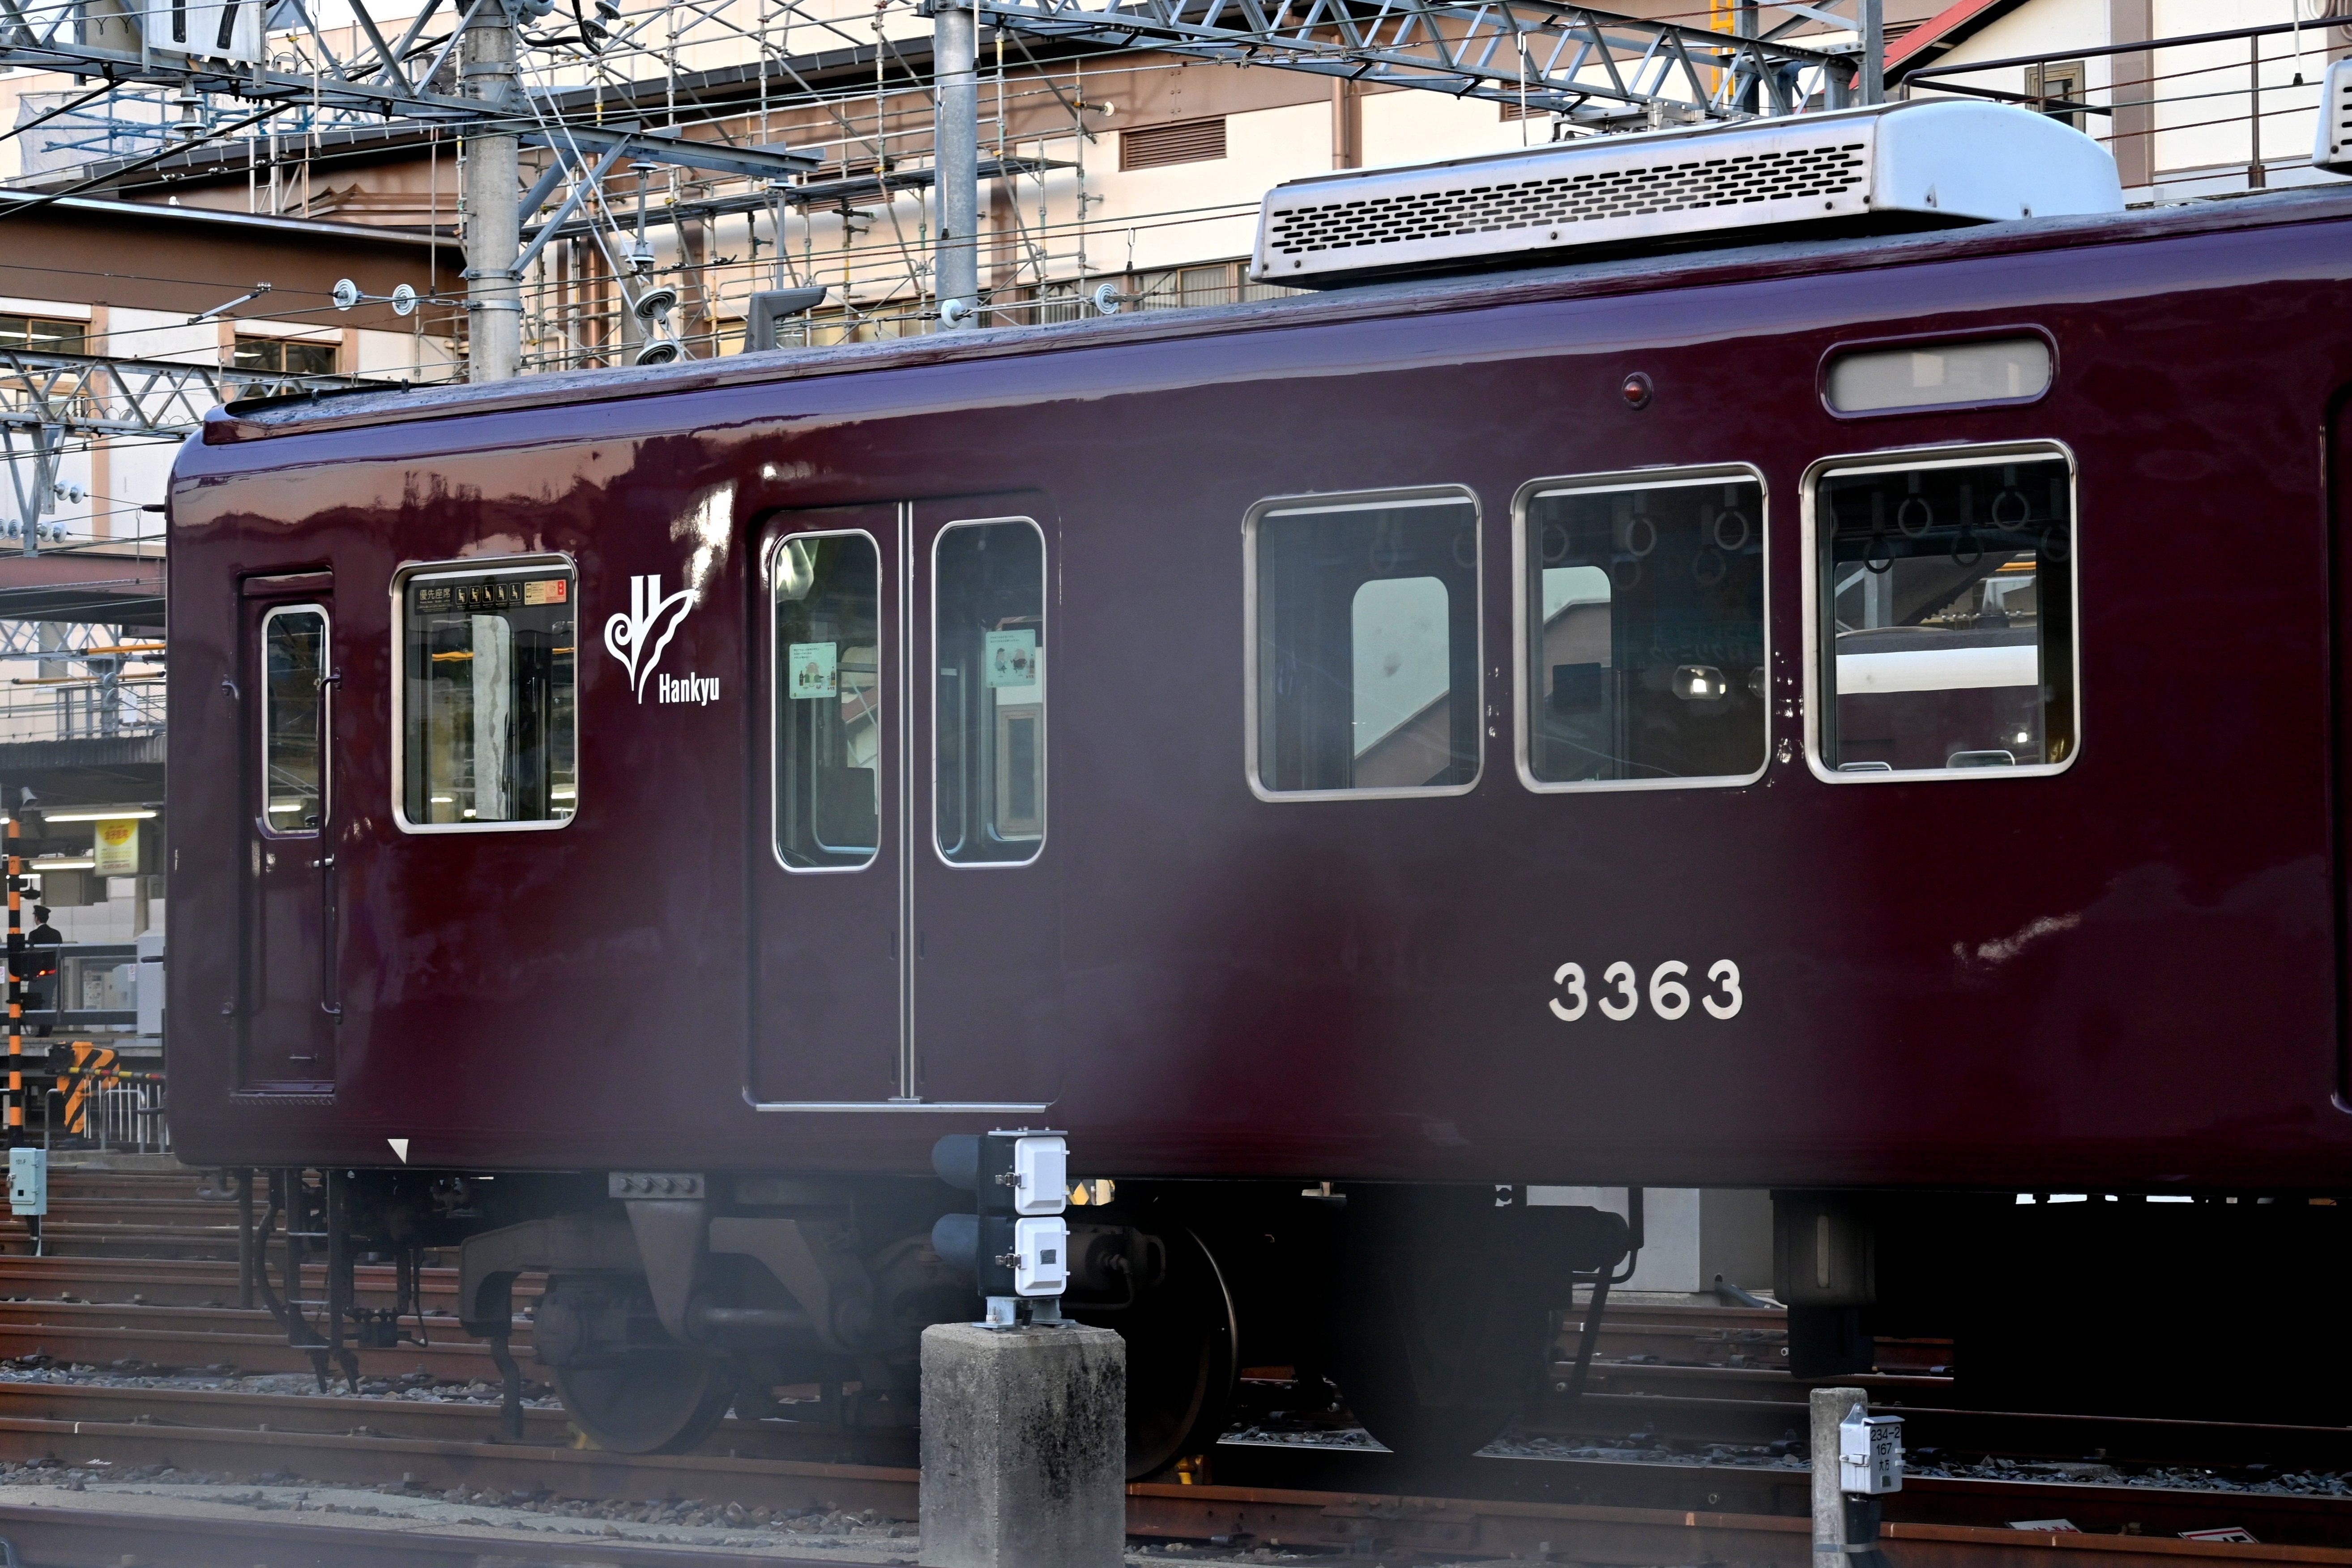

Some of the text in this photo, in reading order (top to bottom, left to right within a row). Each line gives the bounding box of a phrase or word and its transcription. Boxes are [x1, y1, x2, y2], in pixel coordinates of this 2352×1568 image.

[420, 588, 450, 600] 優先座席
[659, 672, 719, 706] Hankyu
[1549, 959, 1742, 1021] 3363
[1871, 1427, 1900, 1441] 234-2
[1877, 1442, 1892, 1455] 167
